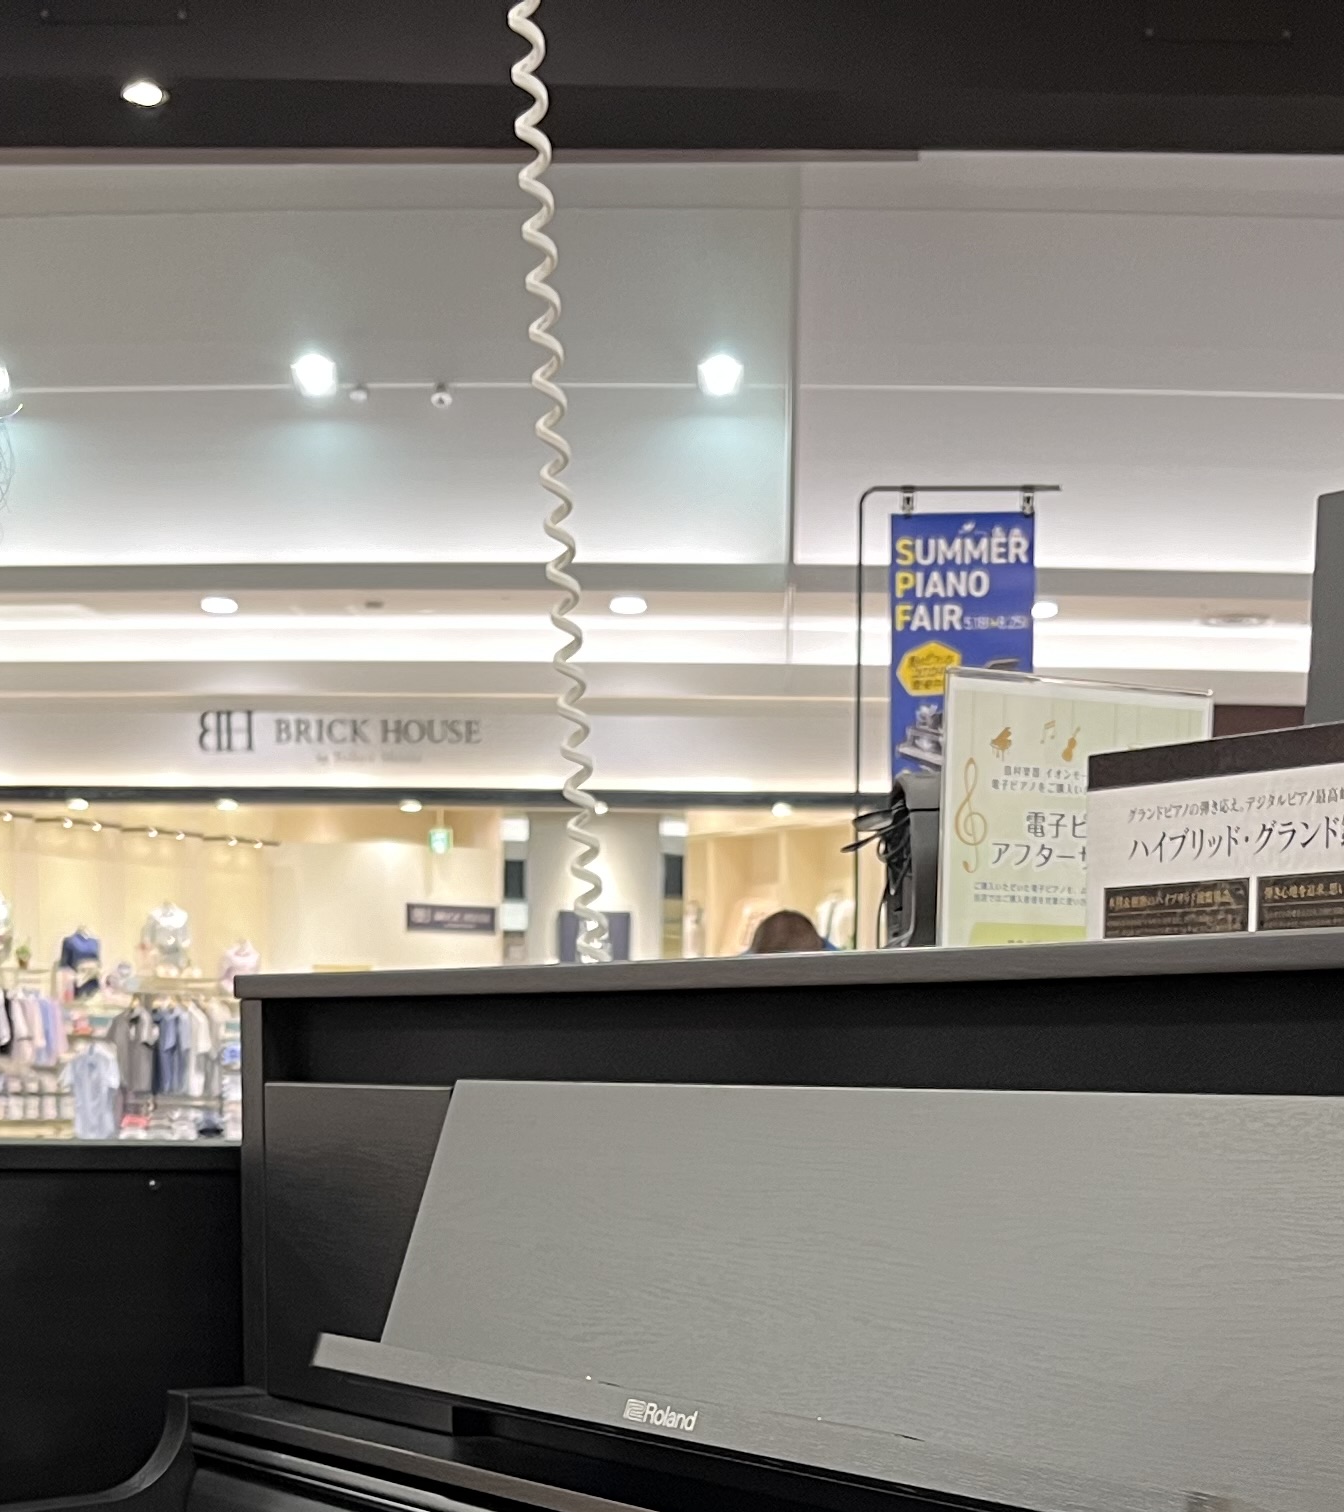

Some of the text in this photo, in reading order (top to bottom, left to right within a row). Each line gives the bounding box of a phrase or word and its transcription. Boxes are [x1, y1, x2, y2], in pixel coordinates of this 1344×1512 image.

[895, 536, 1030, 566] SUMMER
[895, 570, 990, 598] PIANO
[894, 604, 963, 632] FAIR
[274, 718, 371, 744] BRICK
[380, 718, 483, 744] HOUSE
[642, 1403, 699, 1432] Roland
